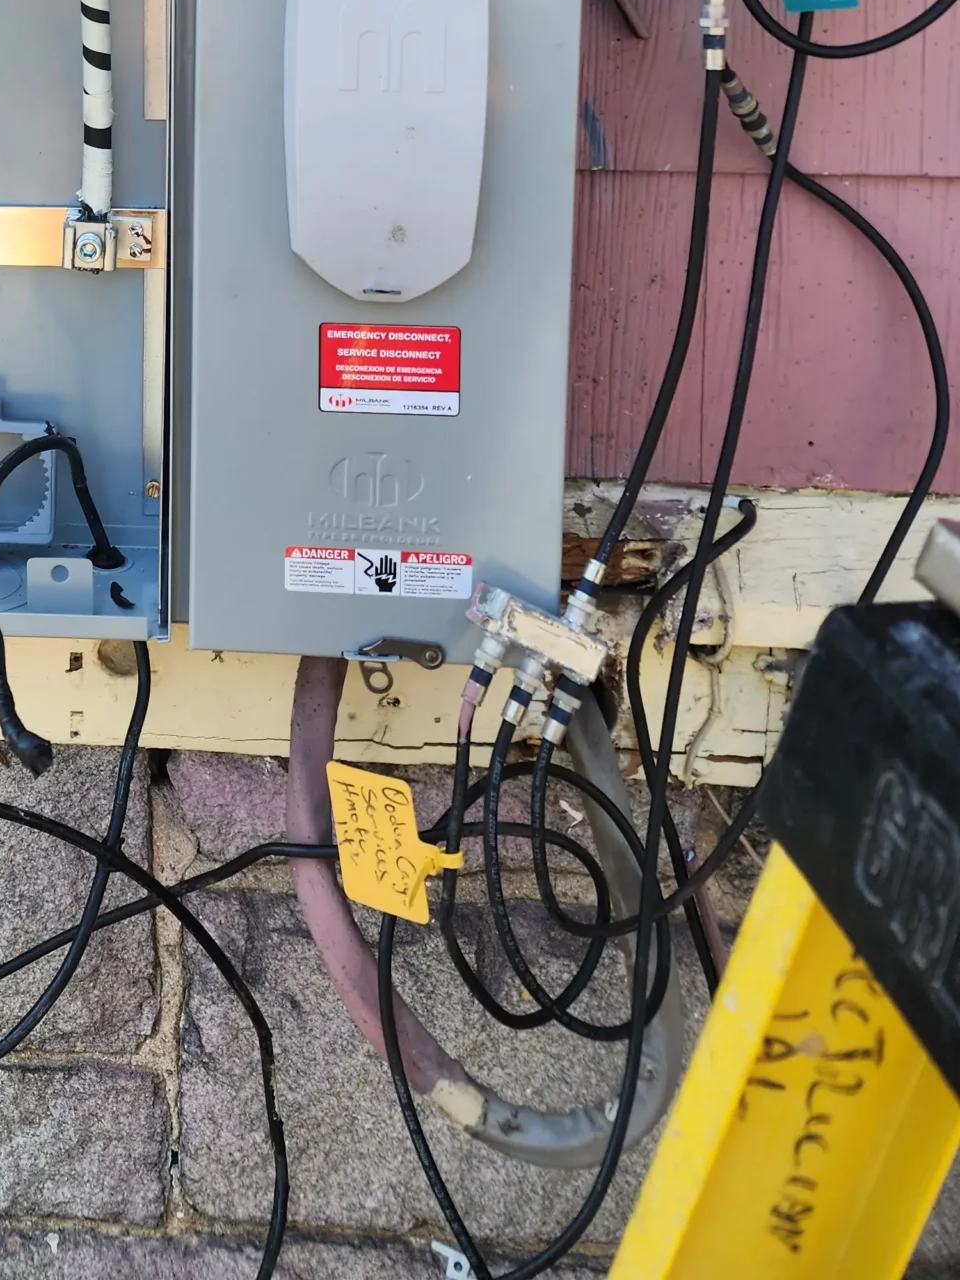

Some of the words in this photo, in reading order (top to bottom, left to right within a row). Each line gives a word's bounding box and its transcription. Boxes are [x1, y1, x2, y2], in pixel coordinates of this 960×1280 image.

[327, 330, 387, 340] EMERGENCY
[388, 332, 451, 343] DISCONNECT,
[337, 348, 378, 358] SERVICE
[379, 349, 441, 360] DISCONNECT
[336, 364, 385, 373] DESCONEXION
[397, 366, 442, 375] EMERGENCIA
[342, 373, 391, 382] DESCONEXION
[403, 375, 436, 384] SERVICIO
[307, 511, 442, 534] MILBANK
[302, 549, 349, 560] DANGER
[418, 554, 467, 565] PELIGRO
